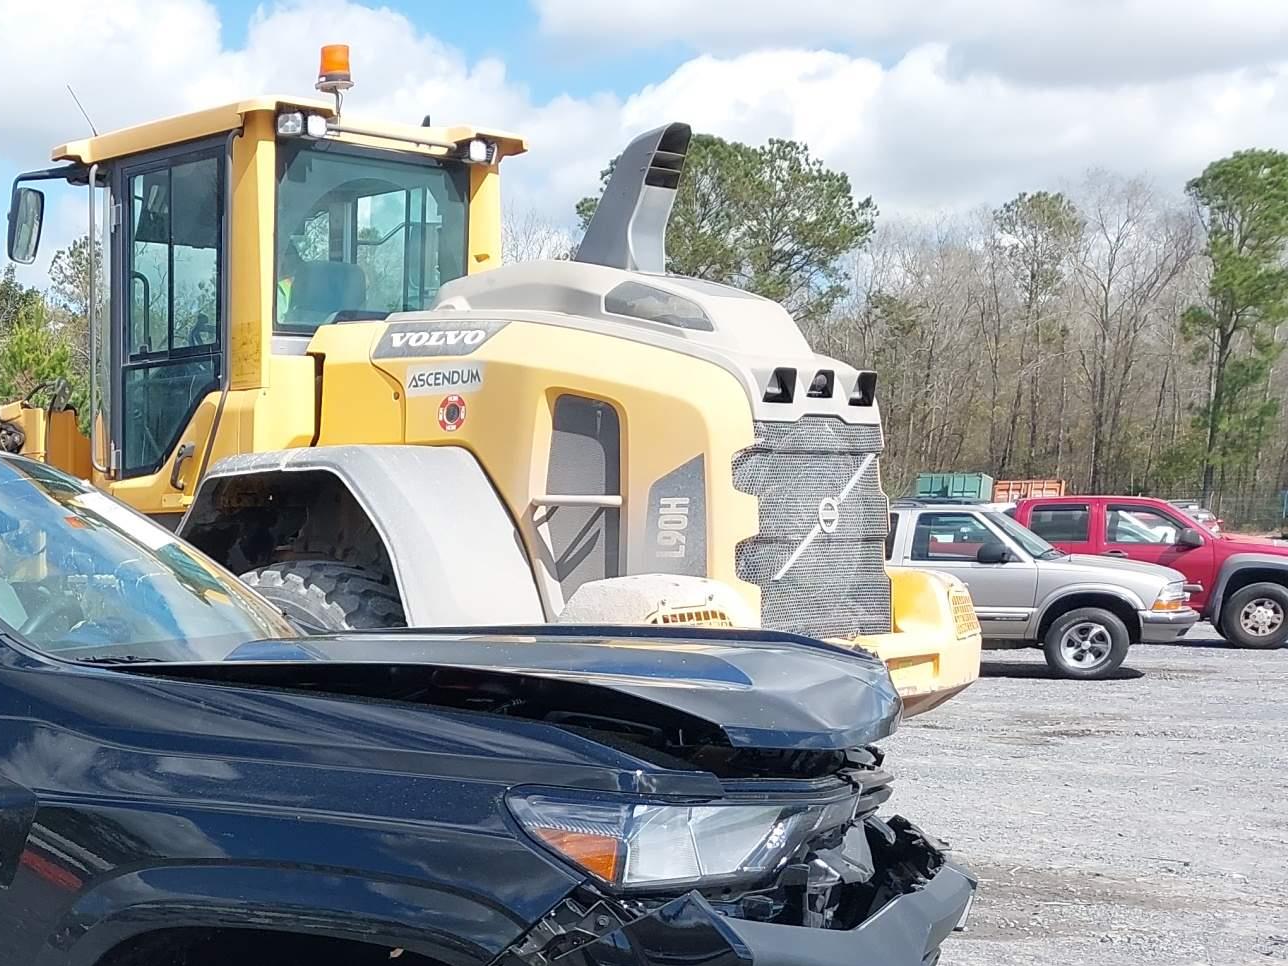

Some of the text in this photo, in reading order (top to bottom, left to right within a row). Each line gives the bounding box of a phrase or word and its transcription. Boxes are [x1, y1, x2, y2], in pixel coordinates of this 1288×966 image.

[390, 329, 486, 348] VOLVO
[407, 368, 482, 389] ASCENDUM
[655, 497, 691, 558] L90H
